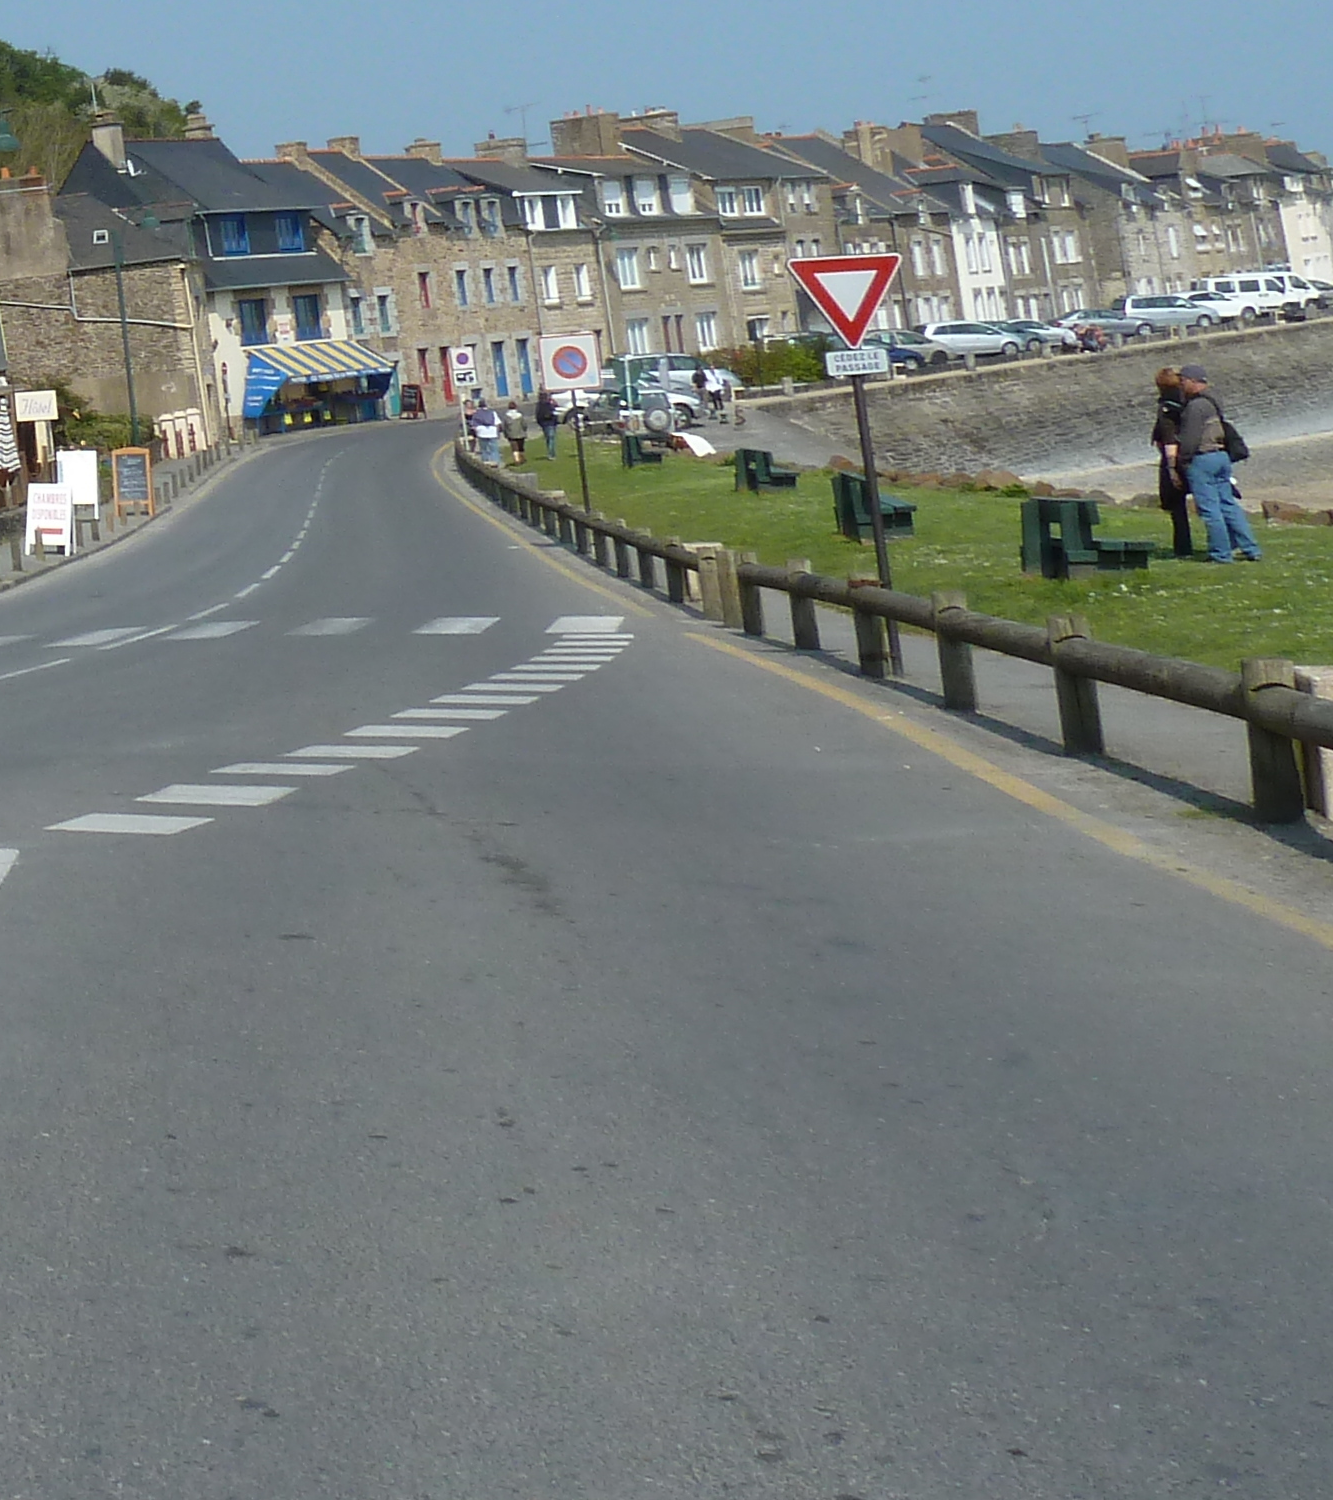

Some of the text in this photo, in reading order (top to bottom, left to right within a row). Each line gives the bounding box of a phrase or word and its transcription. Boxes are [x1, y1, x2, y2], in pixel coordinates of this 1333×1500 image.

[868, 352, 880, 360] LE
[835, 362, 880, 372] PASSAGE
[20, 397, 53, 415] Hôtel
[33, 493, 67, 505] CHAMBRES
